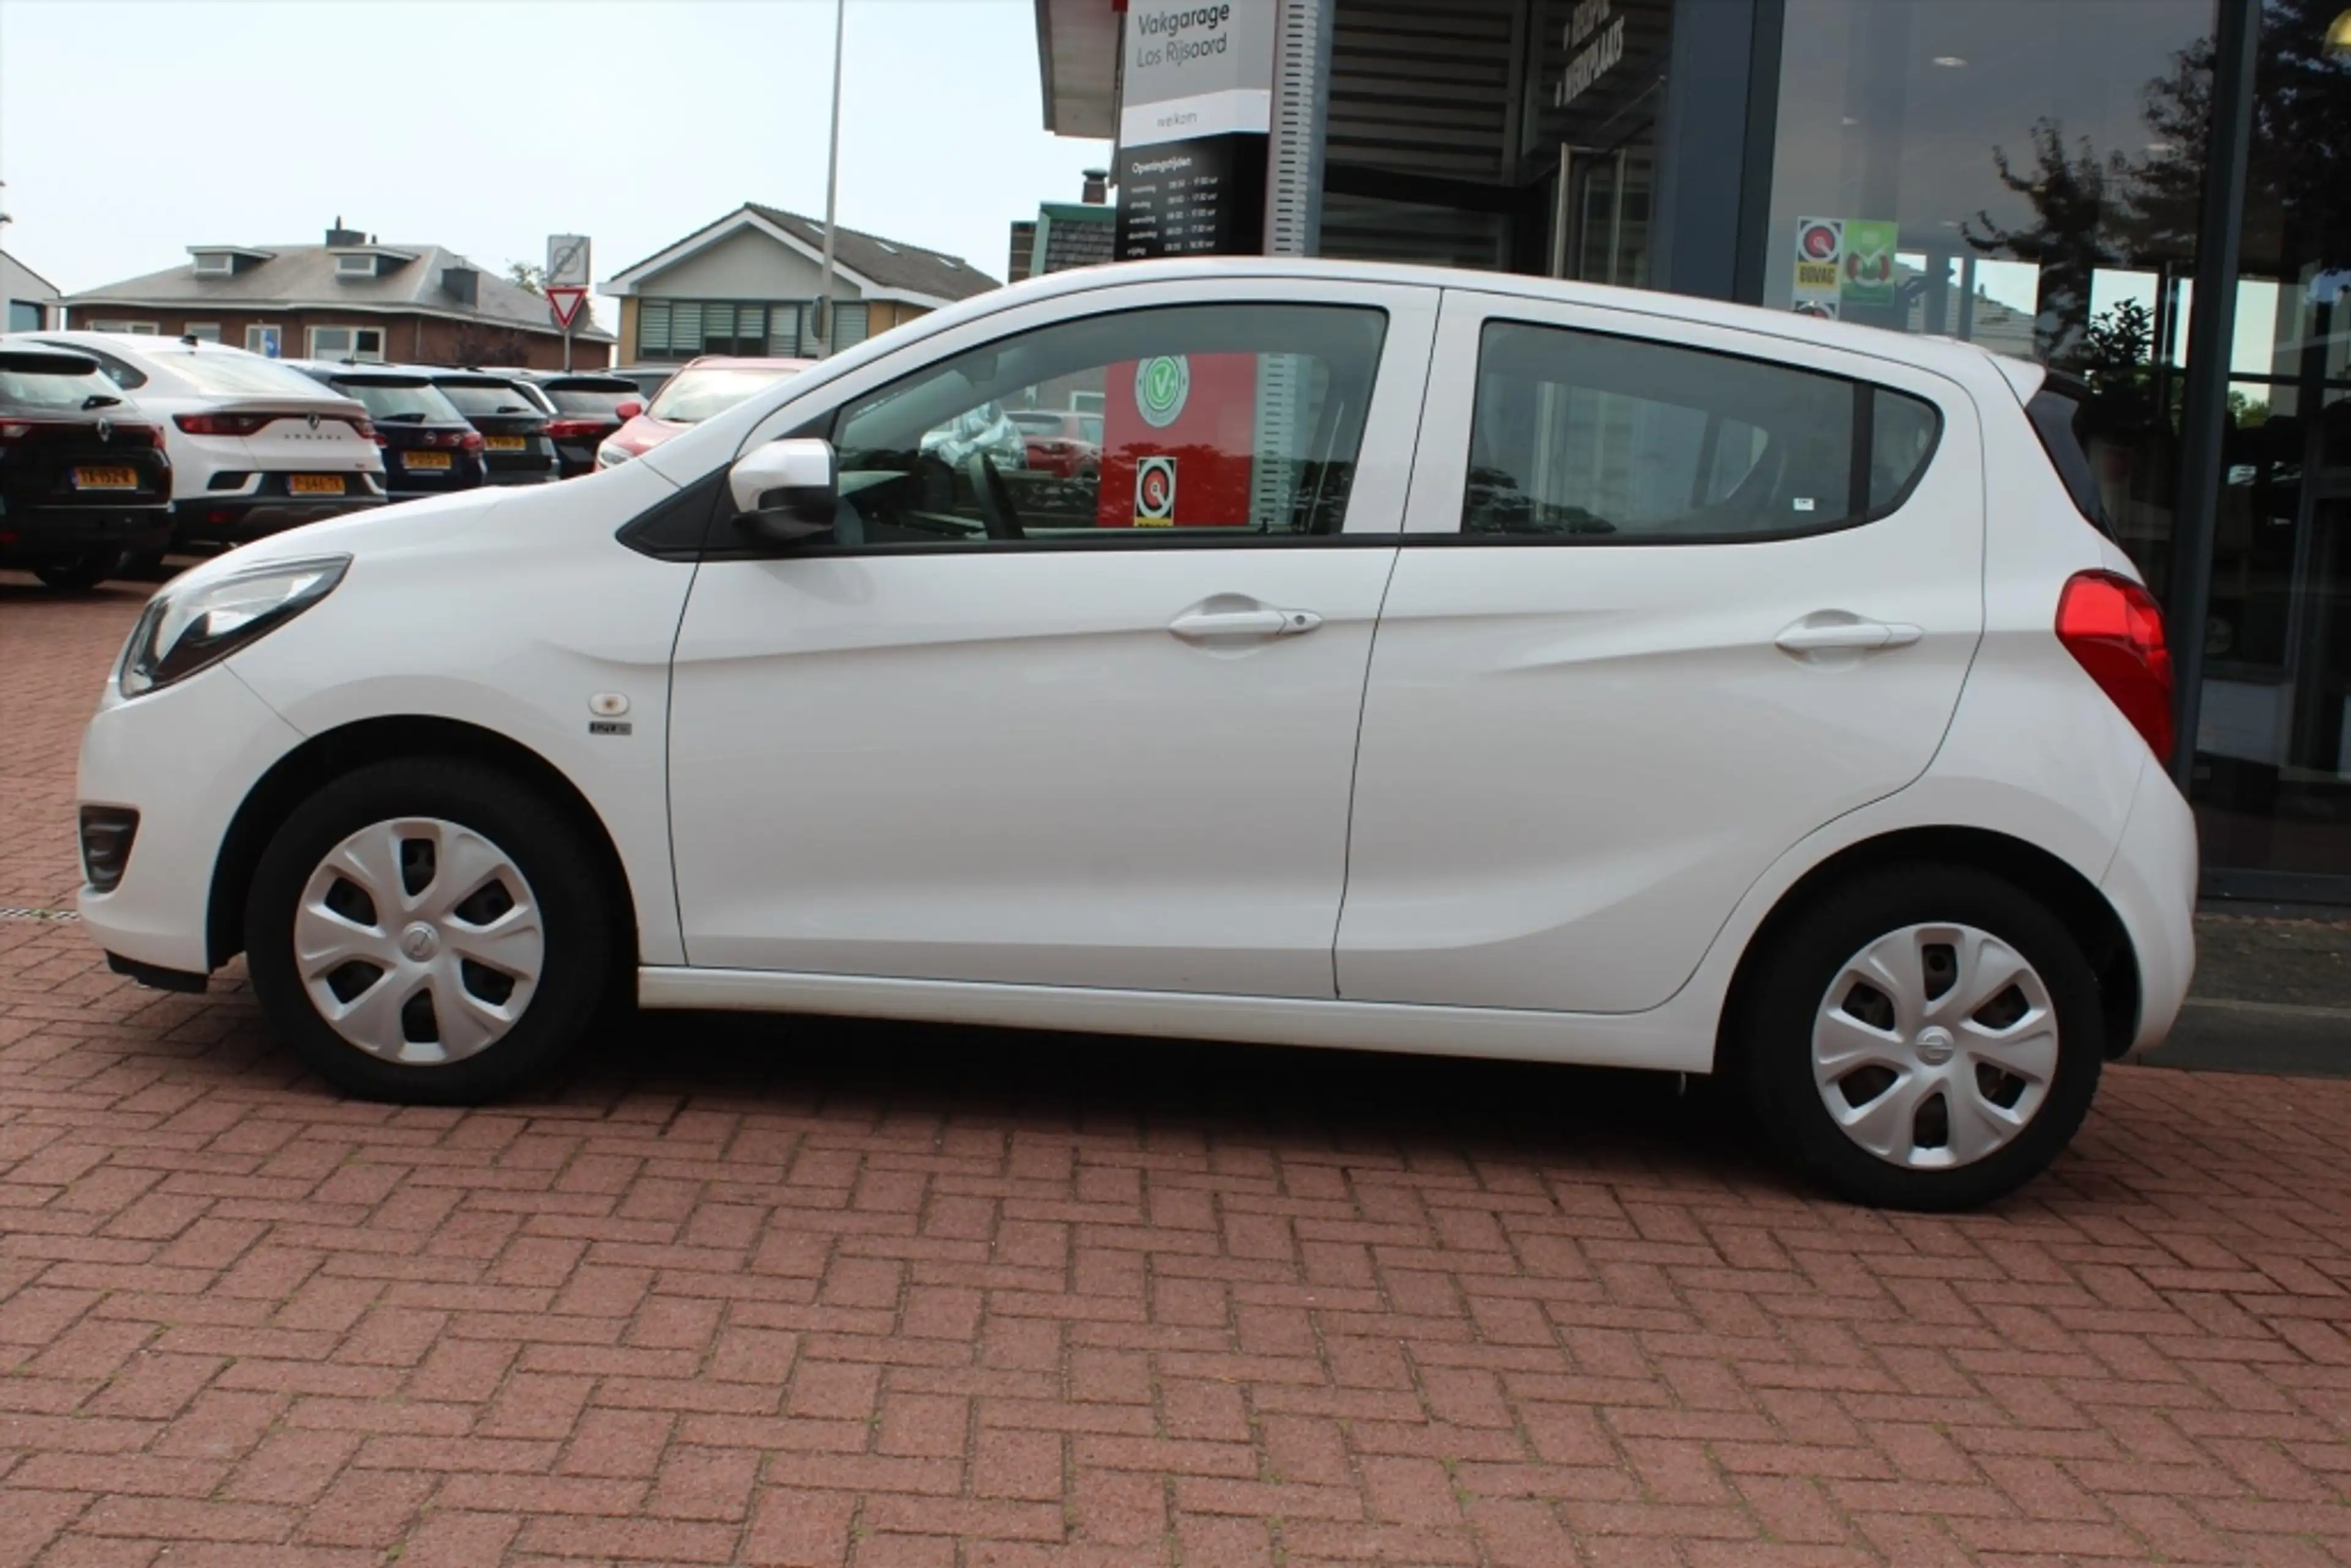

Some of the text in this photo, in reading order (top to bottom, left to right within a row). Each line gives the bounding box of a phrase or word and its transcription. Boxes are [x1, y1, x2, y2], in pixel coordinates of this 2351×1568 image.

[1138, 4, 1229, 37] Vakgarage
[1136, 32, 1227, 68] Los Rijsoord
[1799, 265, 1835, 285] BOVAG
